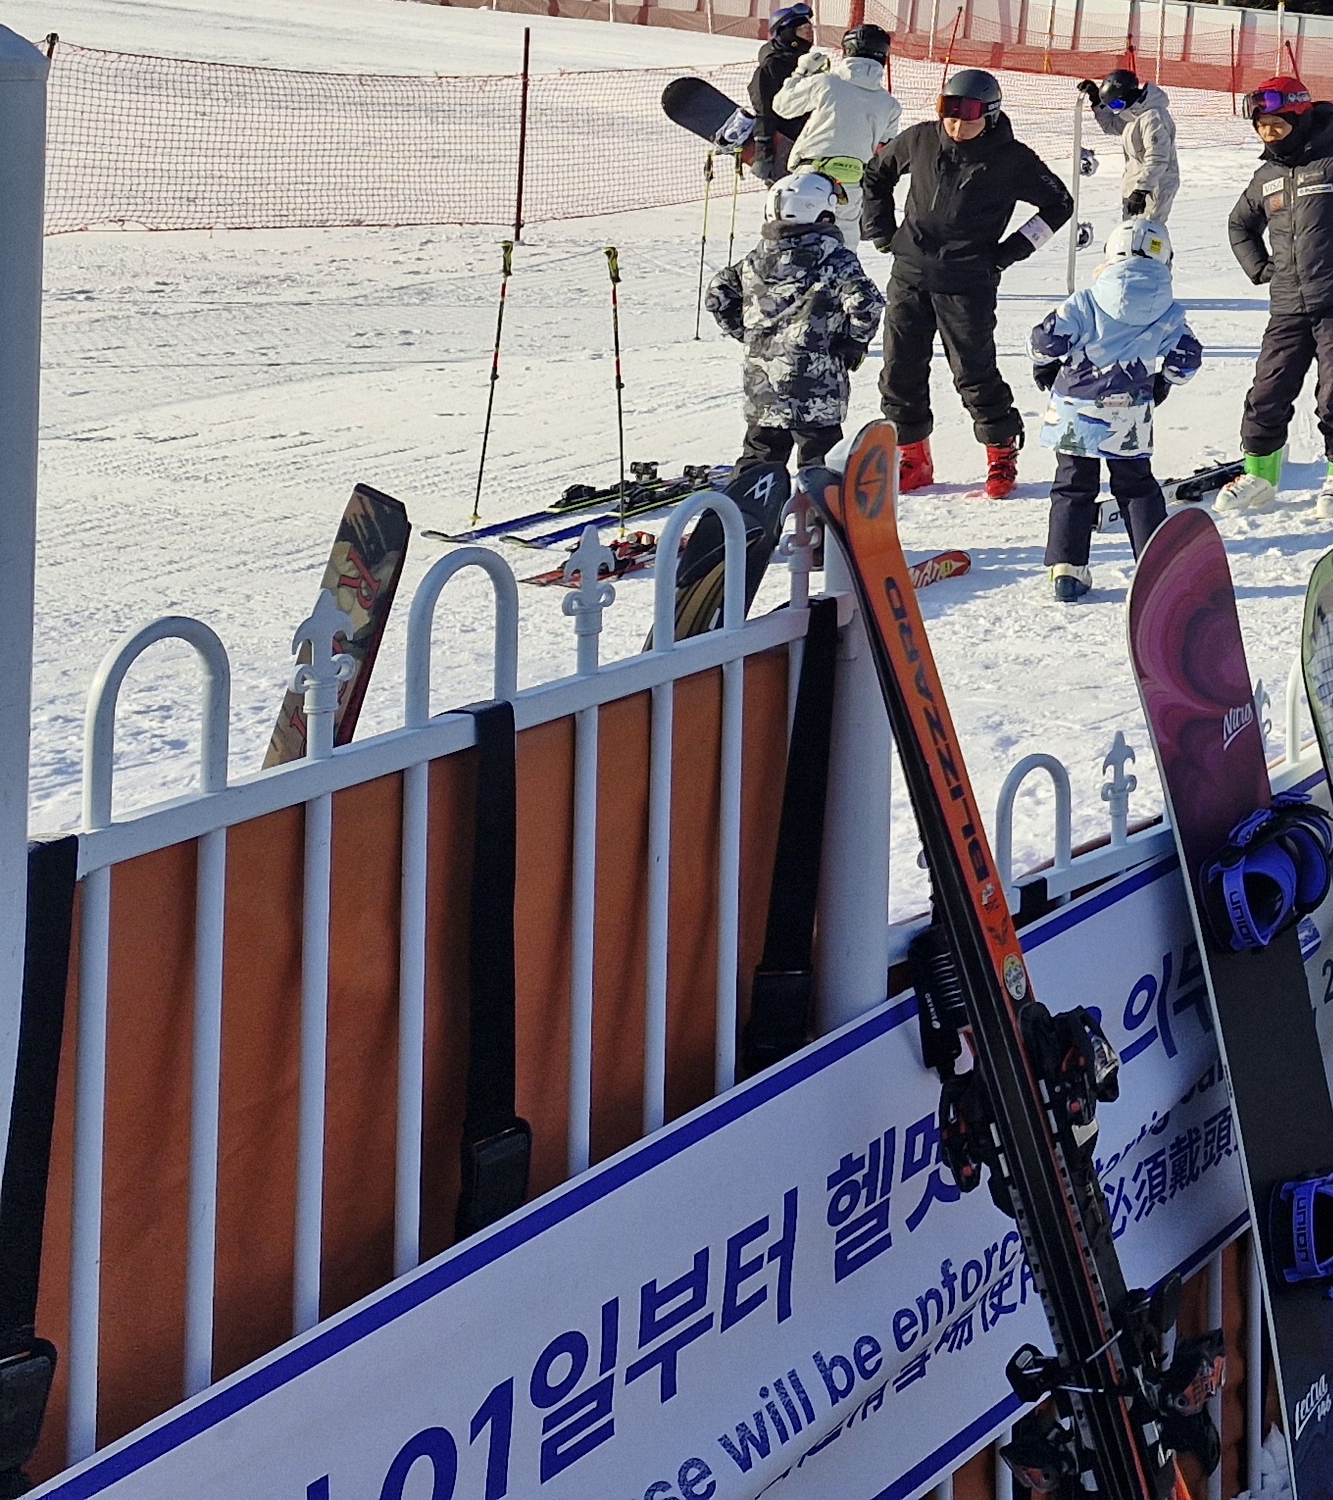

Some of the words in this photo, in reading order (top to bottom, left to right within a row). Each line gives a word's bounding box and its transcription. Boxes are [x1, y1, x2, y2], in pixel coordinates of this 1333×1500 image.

[1264, 180, 1283, 194] VISA
[884, 576, 990, 882] BLIZZARD
[1223, 702, 1253, 746] Nitro
[717, 1368, 816, 1474] will
[812, 1335, 884, 1408] be
[893, 1230, 1027, 1353] enforc
